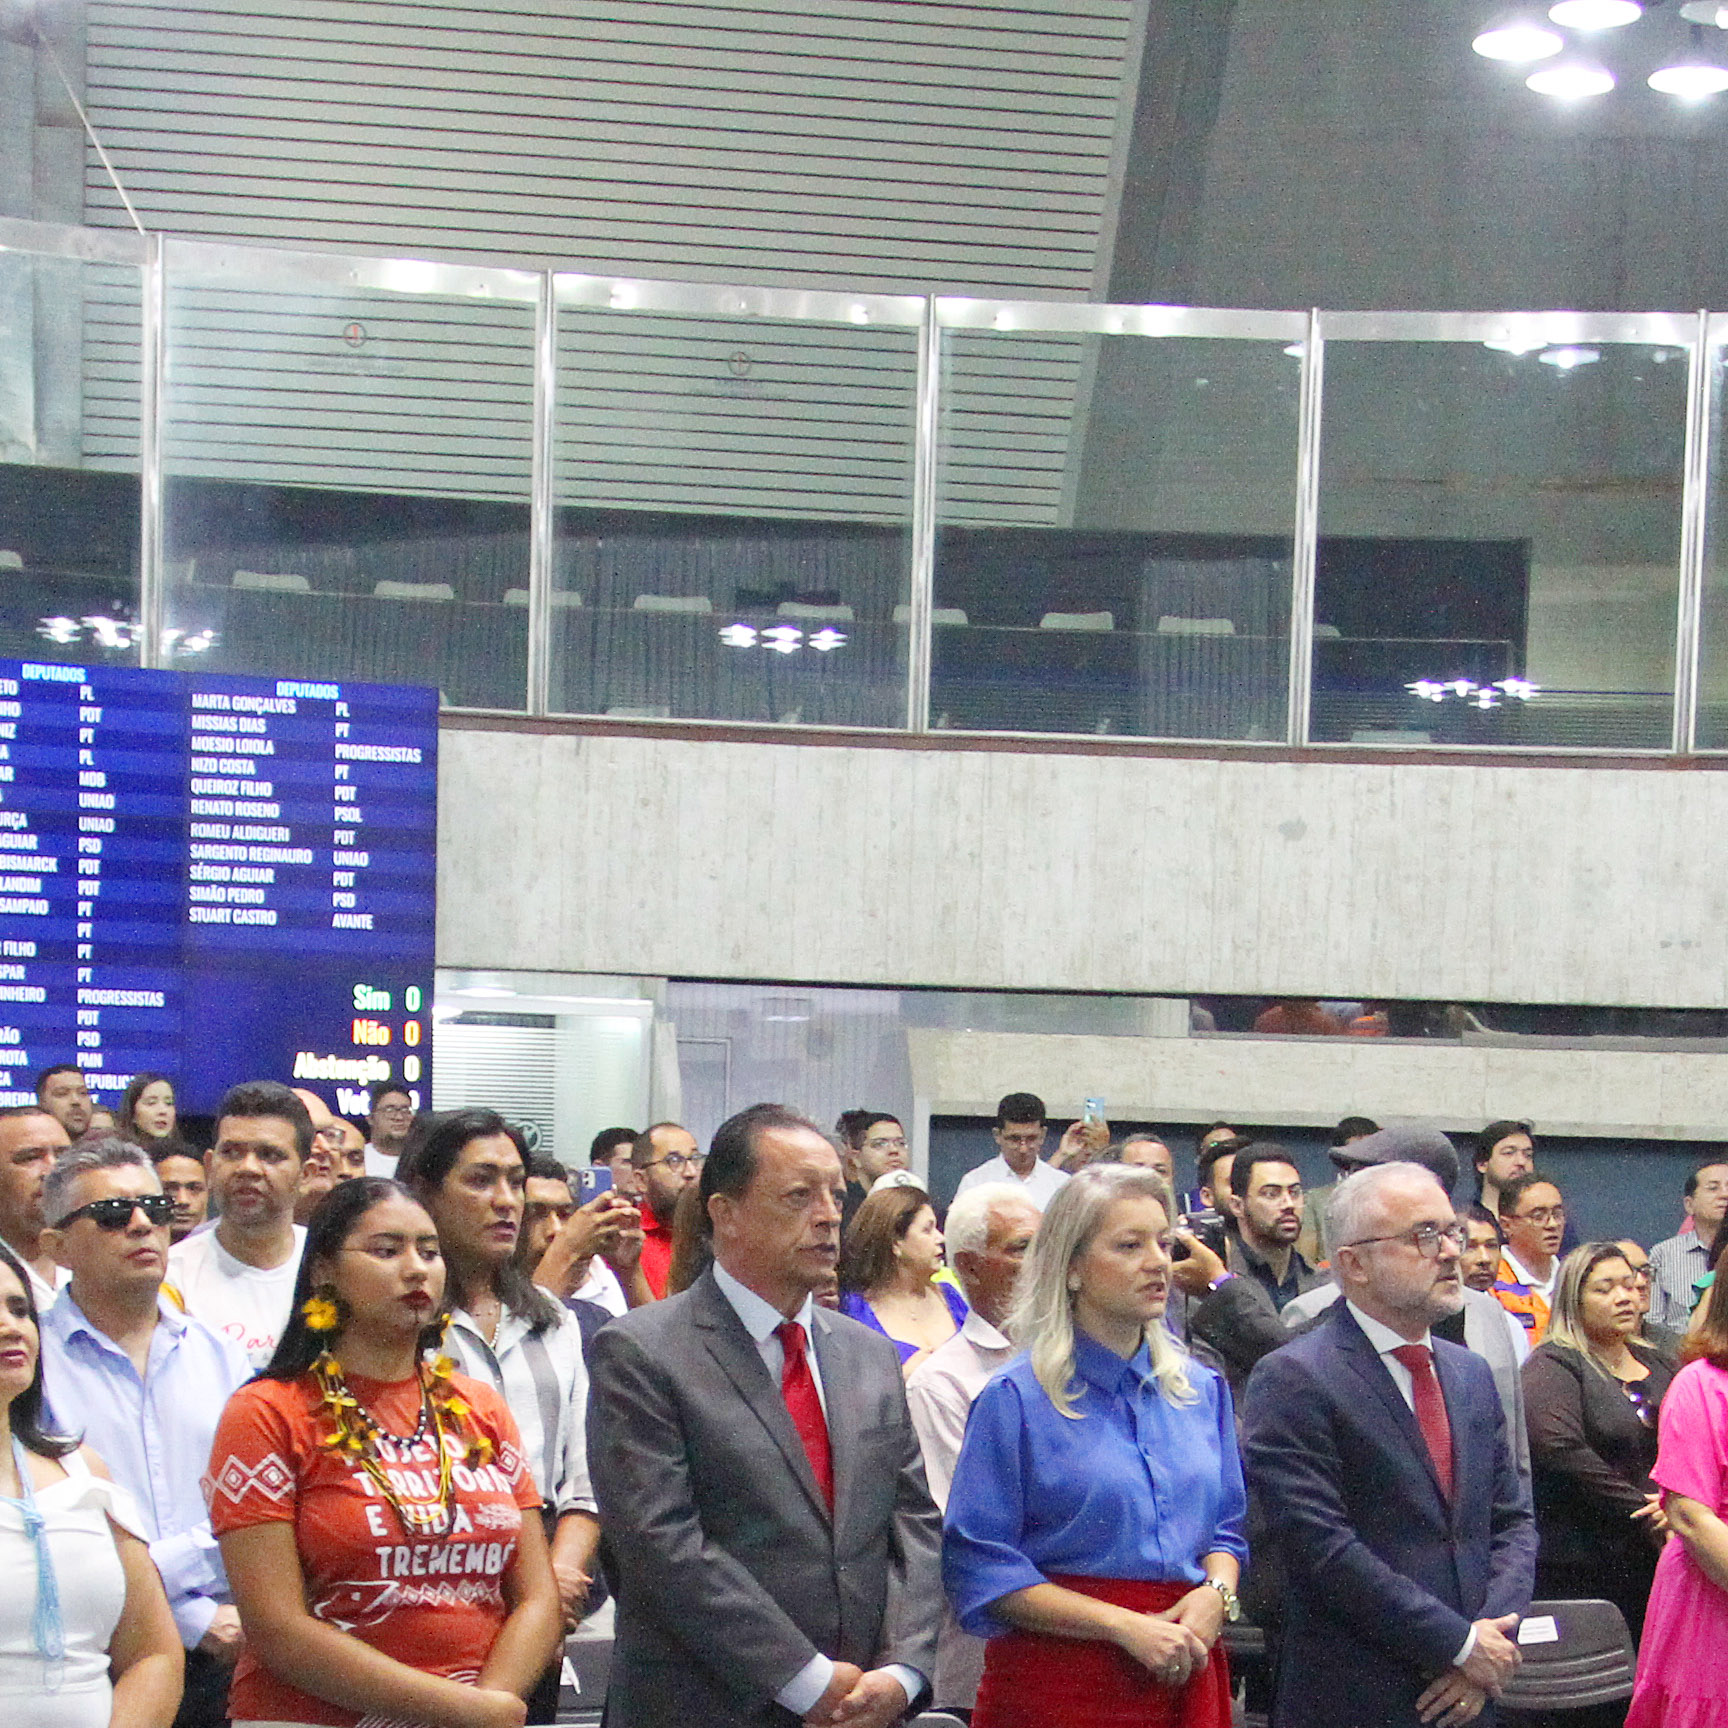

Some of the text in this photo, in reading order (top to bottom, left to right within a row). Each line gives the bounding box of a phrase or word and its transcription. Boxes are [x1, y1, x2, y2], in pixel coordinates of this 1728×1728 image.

[22, 663, 86, 683] DEPUTADOS
[80, 685, 94, 701] PL
[276, 681, 339, 700] DEPUTADOS
[192, 694, 296, 715] MARTA GONÇALVES
[336, 702, 350, 717] PL
[80, 706, 102, 723] PDT
[192, 715, 266, 733] MISSIAS DIAS
[335, 722, 350, 737] PT
[79, 727, 94, 743] PT
[236, 738, 274, 755] LOIOLA
[335, 743, 422, 763] PROGRESSISTAS
[79, 749, 94, 765] PL
[191, 757, 255, 775] NIZO COSTA
[335, 764, 349, 779] PT
[79, 771, 106, 787] MDB
[190, 778, 272, 797] QUEIROZ FILHO
[334, 786, 357, 801] PDT
[191, 800, 280, 818] RENATO ROSENO
[334, 807, 363, 822] PSOL
[190, 823, 290, 841] ROMEU ALDIGUERI
[334, 830, 355, 845] PDT
[78, 837, 102, 853] PSD
[190, 844, 312, 864] SARGENTO REGINAURO
[78, 859, 101, 875] PDT
[190, 862, 274, 883] SÉRGIO AGUIAR
[333, 872, 355, 887] PDT
[78, 880, 101, 896] PDT
[190, 885, 264, 904] SIMÃO PEDRO
[333, 892, 356, 908] PSD
[77, 902, 93, 917] PT
[189, 907, 277, 925] STUART CASTRO
[332, 913, 373, 929] AVANTE
[77, 923, 92, 938] PT
[3, 940, 36, 957] FILHO
[77, 944, 92, 959] PT
[77, 967, 92, 983] PT
[77, 989, 165, 1007] PROGRESSISTAS
[353, 983, 421, 1012] Sim 0
[77, 1010, 100, 1025] PDT
[76, 1031, 101, 1046] PSD
[352, 1019, 420, 1046] Não 0
[293, 1052, 420, 1086] Abstenção 0
[365, 1505, 388, 1537] E
